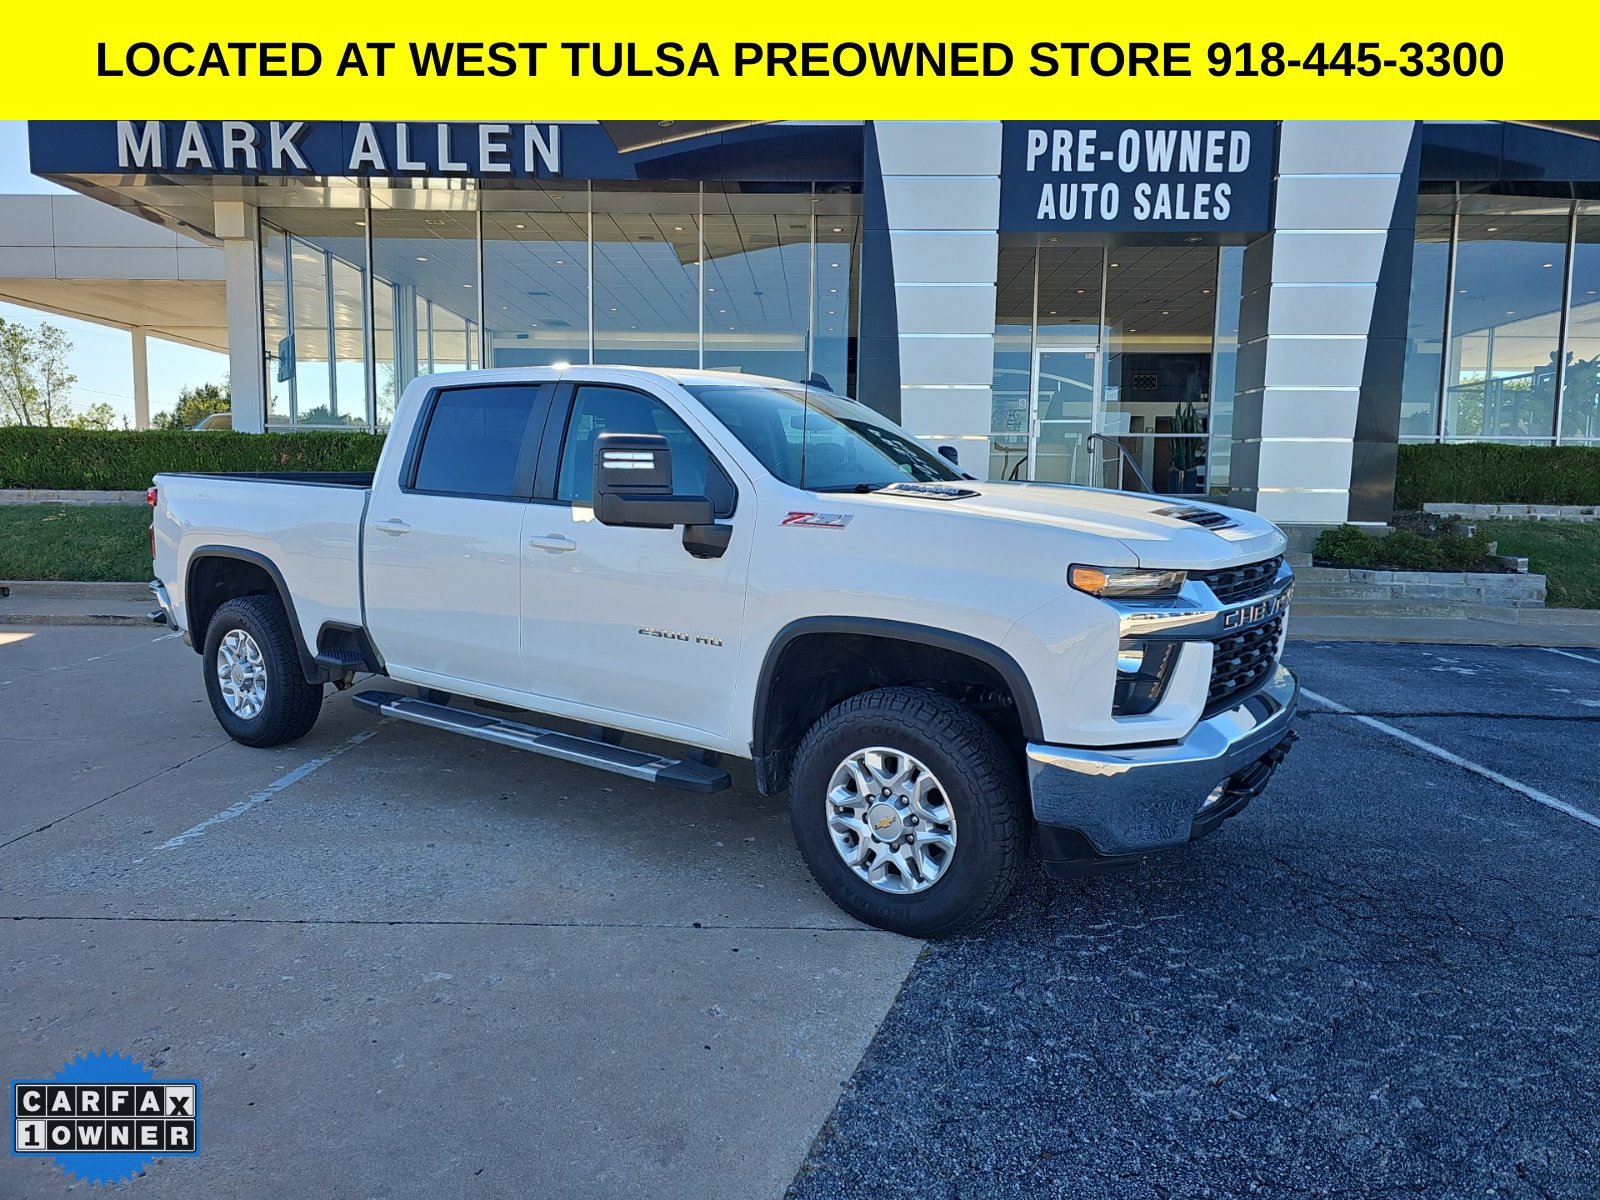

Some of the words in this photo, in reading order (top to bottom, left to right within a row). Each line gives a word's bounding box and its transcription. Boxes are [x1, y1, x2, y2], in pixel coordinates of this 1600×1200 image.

[116, 120, 308, 169] MARK
[348, 122, 562, 173] ALLEN
[1026, 128, 1251, 173] PRE-OWNED
[1036, 182, 1120, 221] AUTO
[1133, 182, 1232, 221] SALES
[638, 625, 690, 642] 2500
[695, 634, 723, 647] HD
